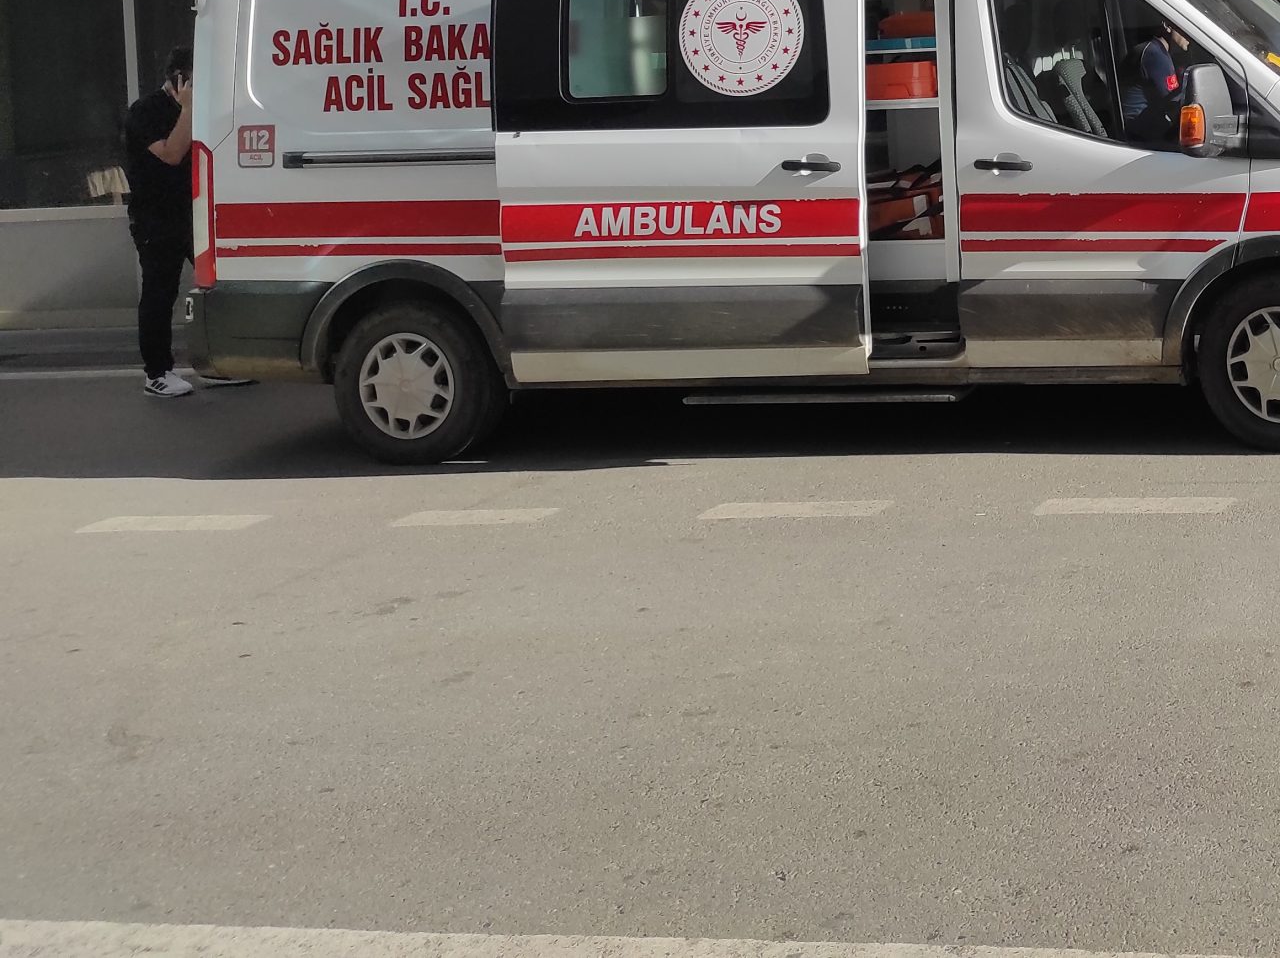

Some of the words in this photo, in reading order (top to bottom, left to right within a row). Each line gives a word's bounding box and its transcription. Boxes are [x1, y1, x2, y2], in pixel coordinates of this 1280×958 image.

[272, 22, 384, 66] SAĞLIK
[323, 67, 393, 112] ACİL
[243, 130, 269, 150] 112
[574, 204, 782, 237] AMBULANS
